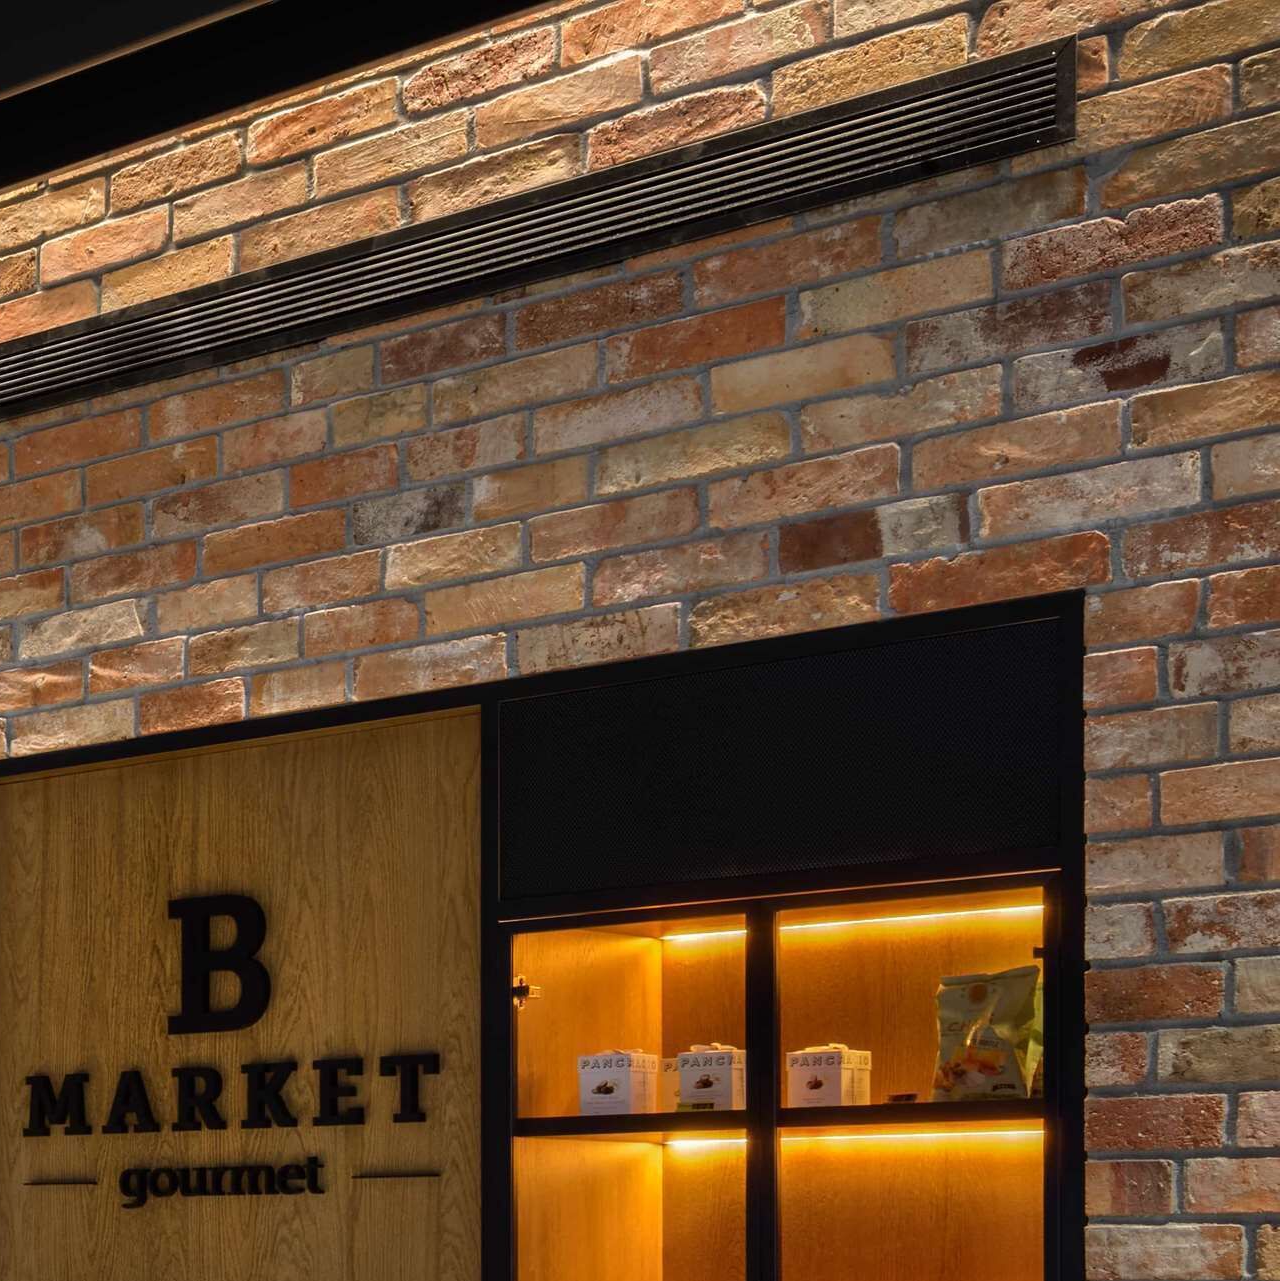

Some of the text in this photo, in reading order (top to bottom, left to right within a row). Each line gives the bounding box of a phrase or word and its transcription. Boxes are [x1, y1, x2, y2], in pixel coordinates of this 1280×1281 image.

[168, 894, 272, 1035] B
[23, 1053, 441, 1137] MARKET
[119, 1156, 325, 1209] gourmet
